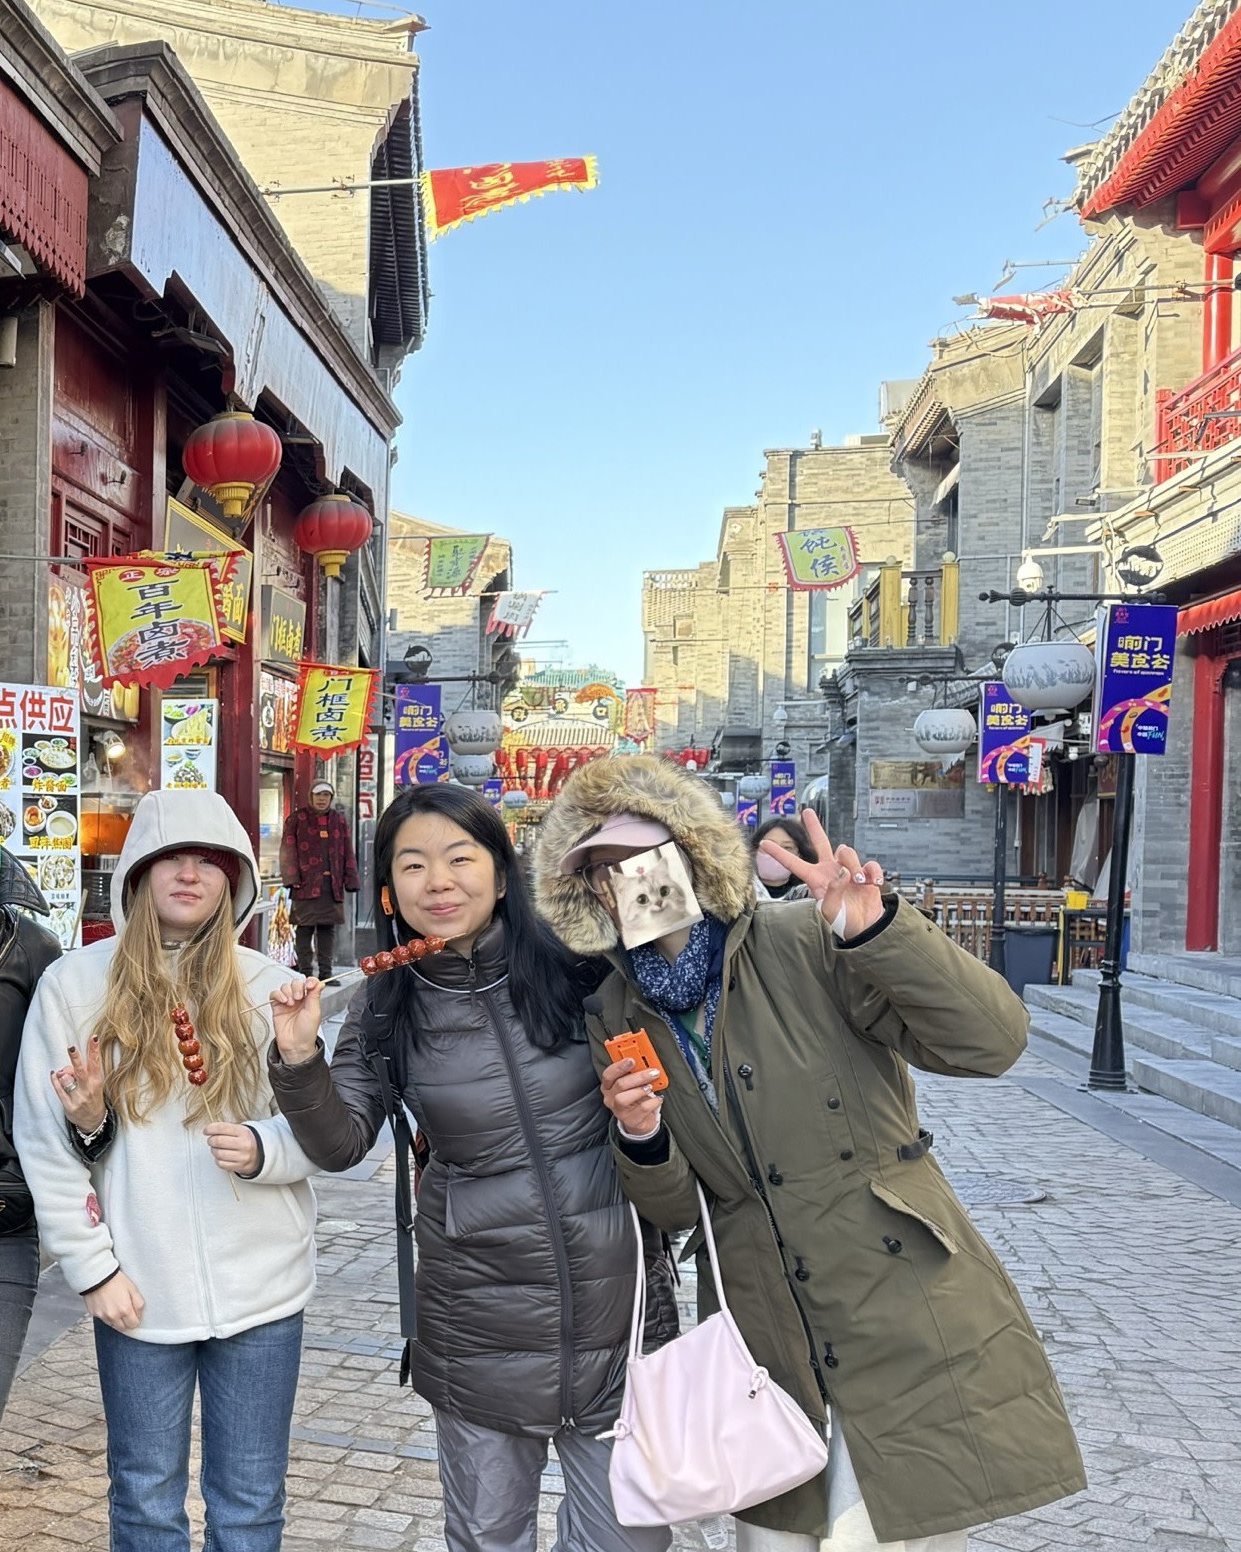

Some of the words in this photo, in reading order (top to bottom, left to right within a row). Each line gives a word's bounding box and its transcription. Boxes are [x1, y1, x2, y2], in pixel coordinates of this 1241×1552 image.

[798, 529, 840, 578] 饨侯
[127, 579, 190, 670] 百年卤煮
[310, 677, 353, 742] 门框卤煮
